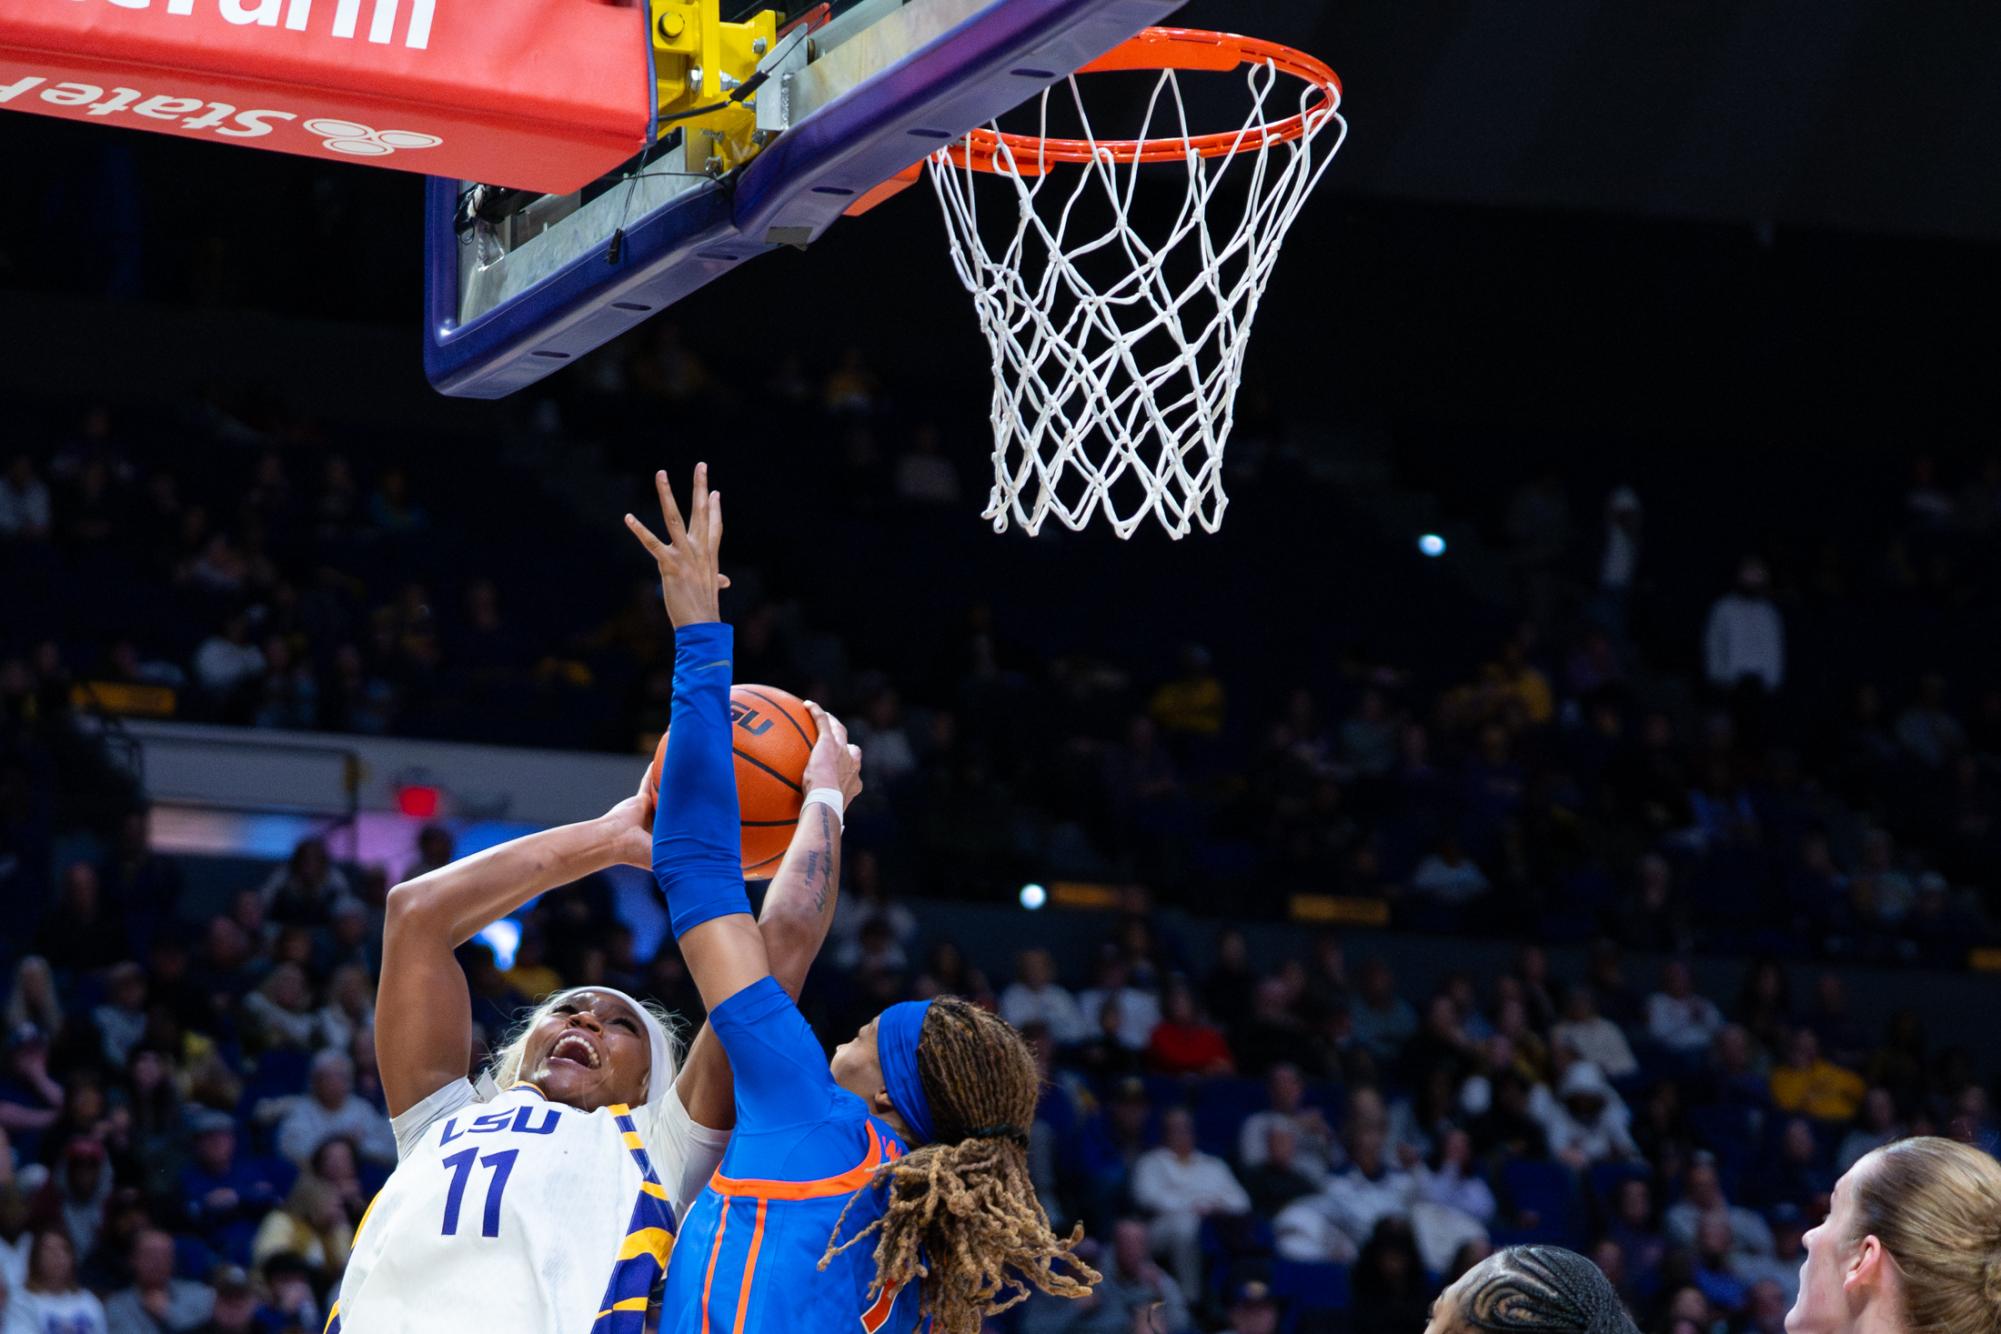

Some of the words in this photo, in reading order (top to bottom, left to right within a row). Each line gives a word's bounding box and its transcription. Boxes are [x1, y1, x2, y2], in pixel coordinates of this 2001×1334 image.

[730, 700, 774, 736] SU
[439, 1106, 562, 1147] LSU
[441, 1147, 519, 1237] 11
